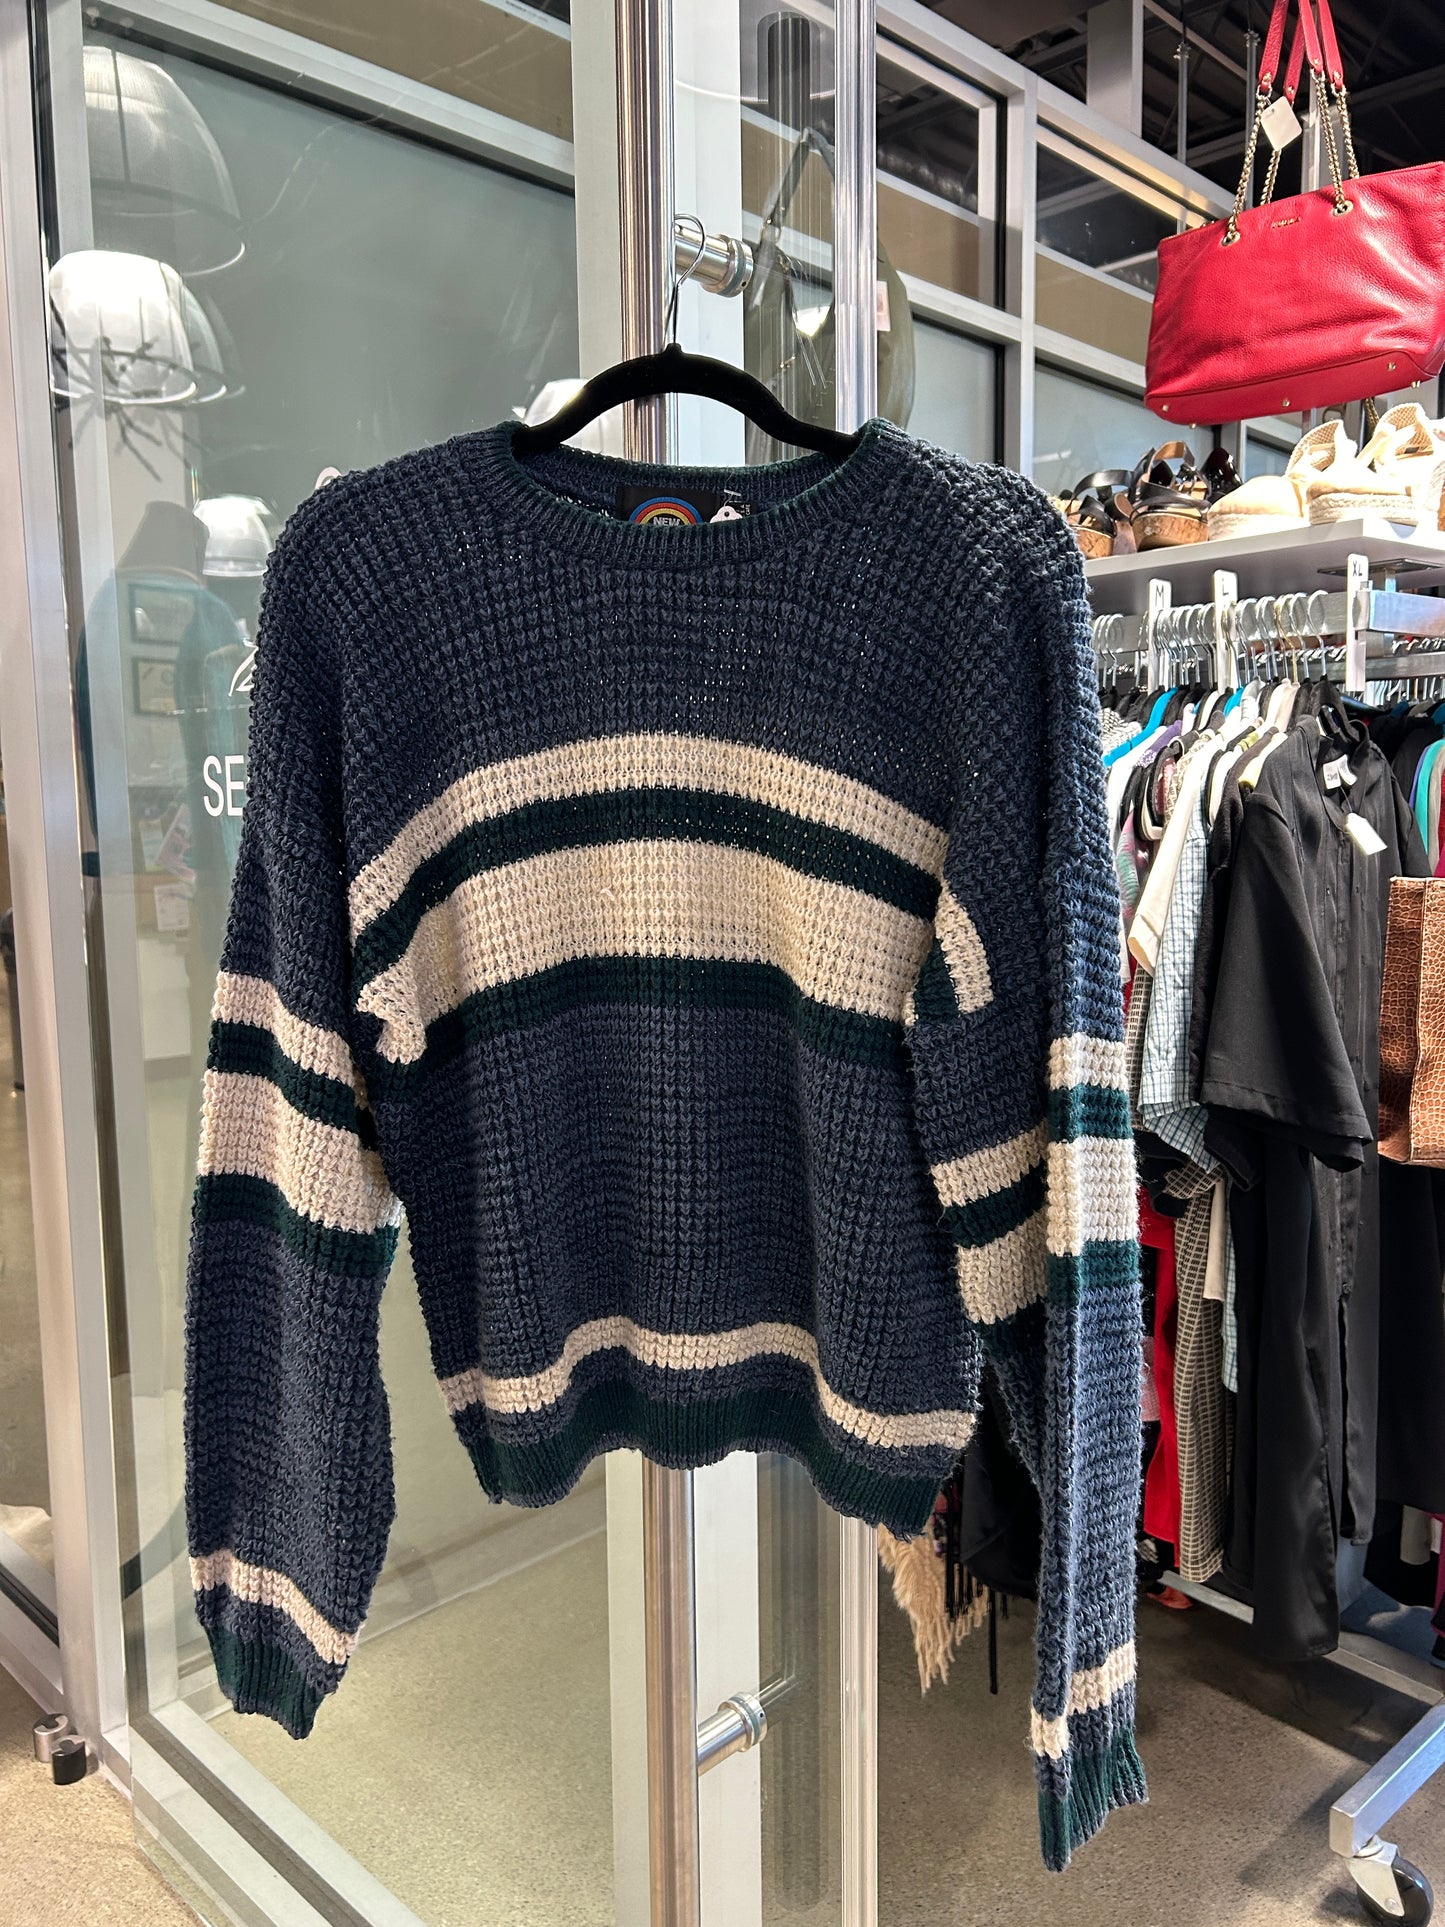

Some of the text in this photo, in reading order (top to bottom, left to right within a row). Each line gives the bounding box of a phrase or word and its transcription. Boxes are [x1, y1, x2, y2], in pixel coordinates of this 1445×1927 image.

[653, 516, 680, 526] NEW
[1352, 560, 1363, 577] XL
[1155, 584, 1165, 608] M
[1221, 576, 1230, 596] L
[203, 755, 250, 817] SE
